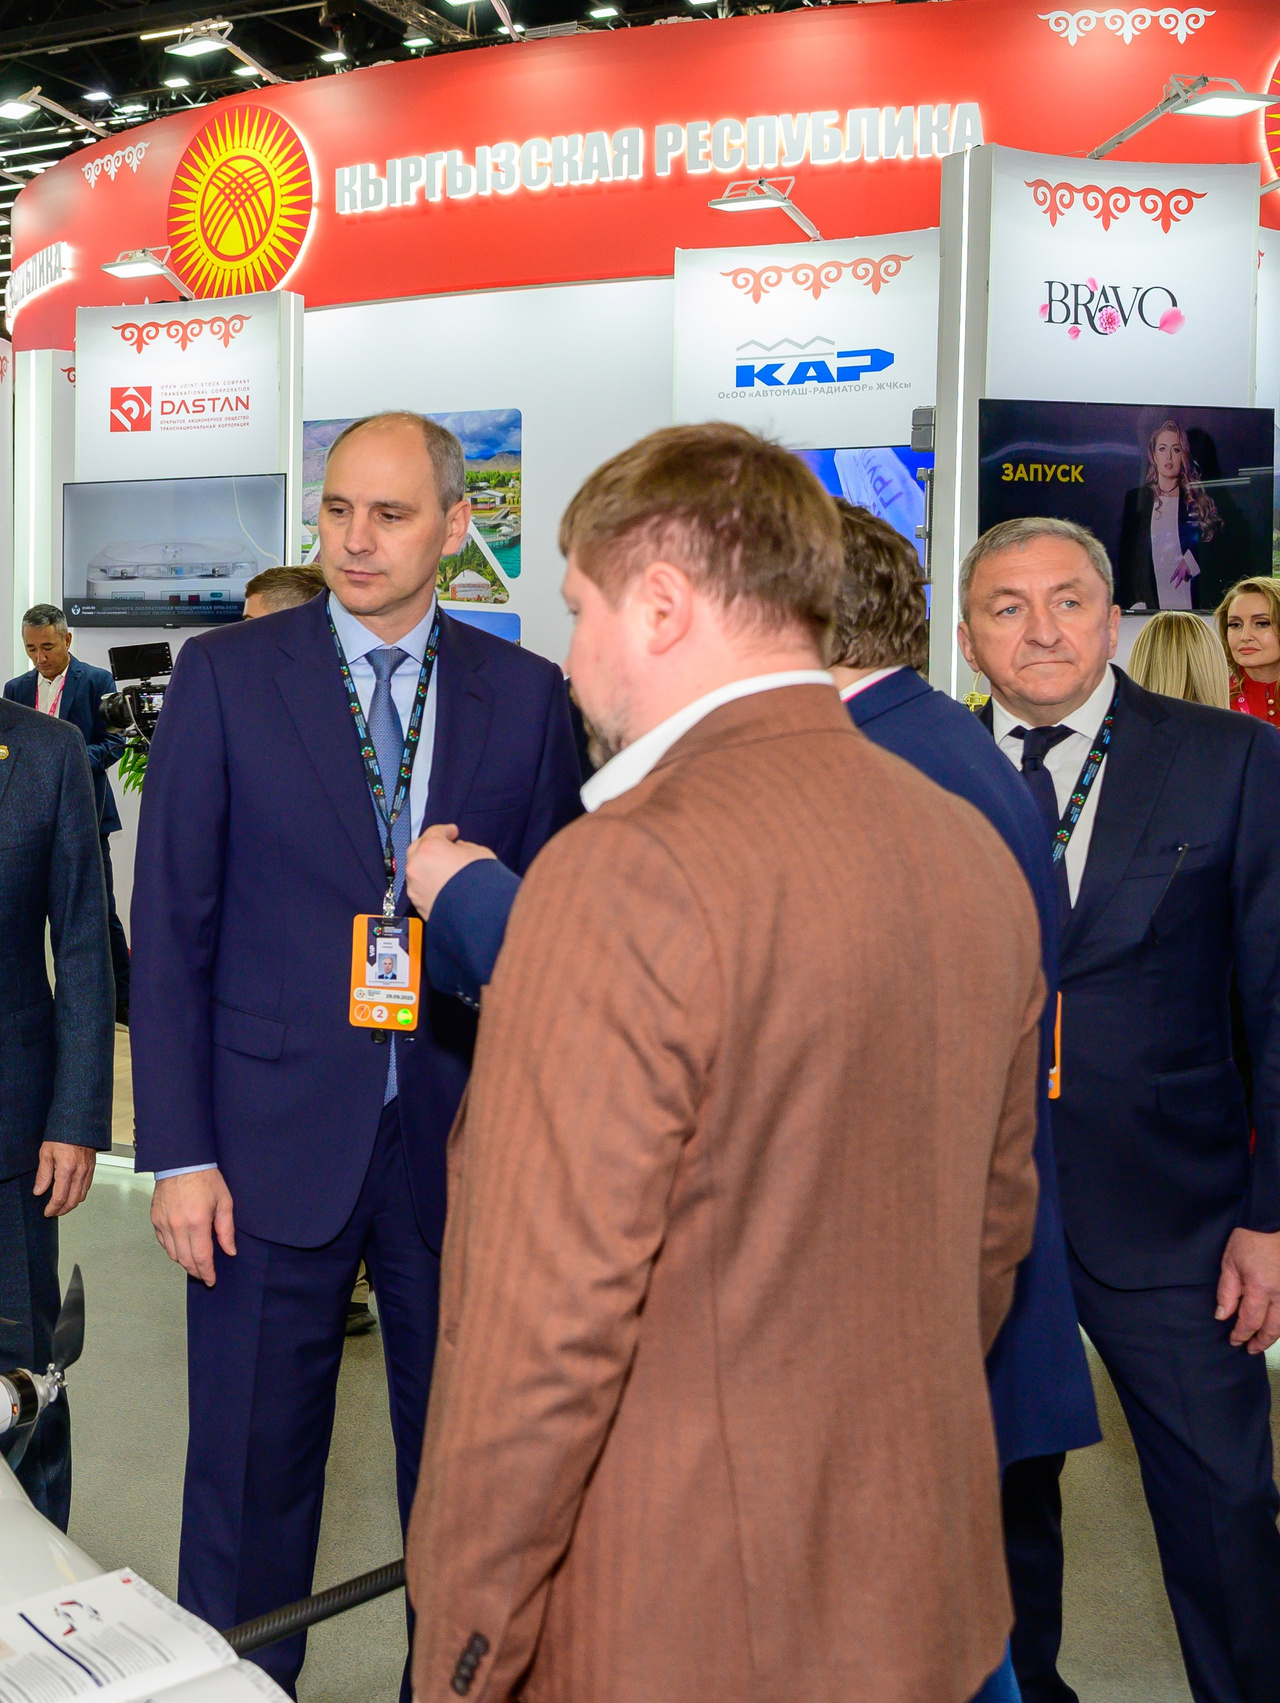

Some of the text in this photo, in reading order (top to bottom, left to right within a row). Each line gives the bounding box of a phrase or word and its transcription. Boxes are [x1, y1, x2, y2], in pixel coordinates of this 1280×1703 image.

[335, 102, 984, 214] КЫРГЫЗСКАЯ РЕСПУБЛИКА
[1044, 280, 1179, 336] BRAVO
[736, 348, 895, 388] КАР
[211, 386, 250, 394] CORPORATION
[749, 384, 873, 398] «АВТОМАШ-РАДИАТОР»
[160, 395, 250, 415] DASTAN
[160, 424, 216, 432] ТРАНСНАЦИОНАЛЬНАЯ
[188, 416, 223, 424] АКЦИОНЕРНОЕ
[1001, 463, 1084, 483] ЗАПУСК
[376, 1009, 384, 1018] 2
